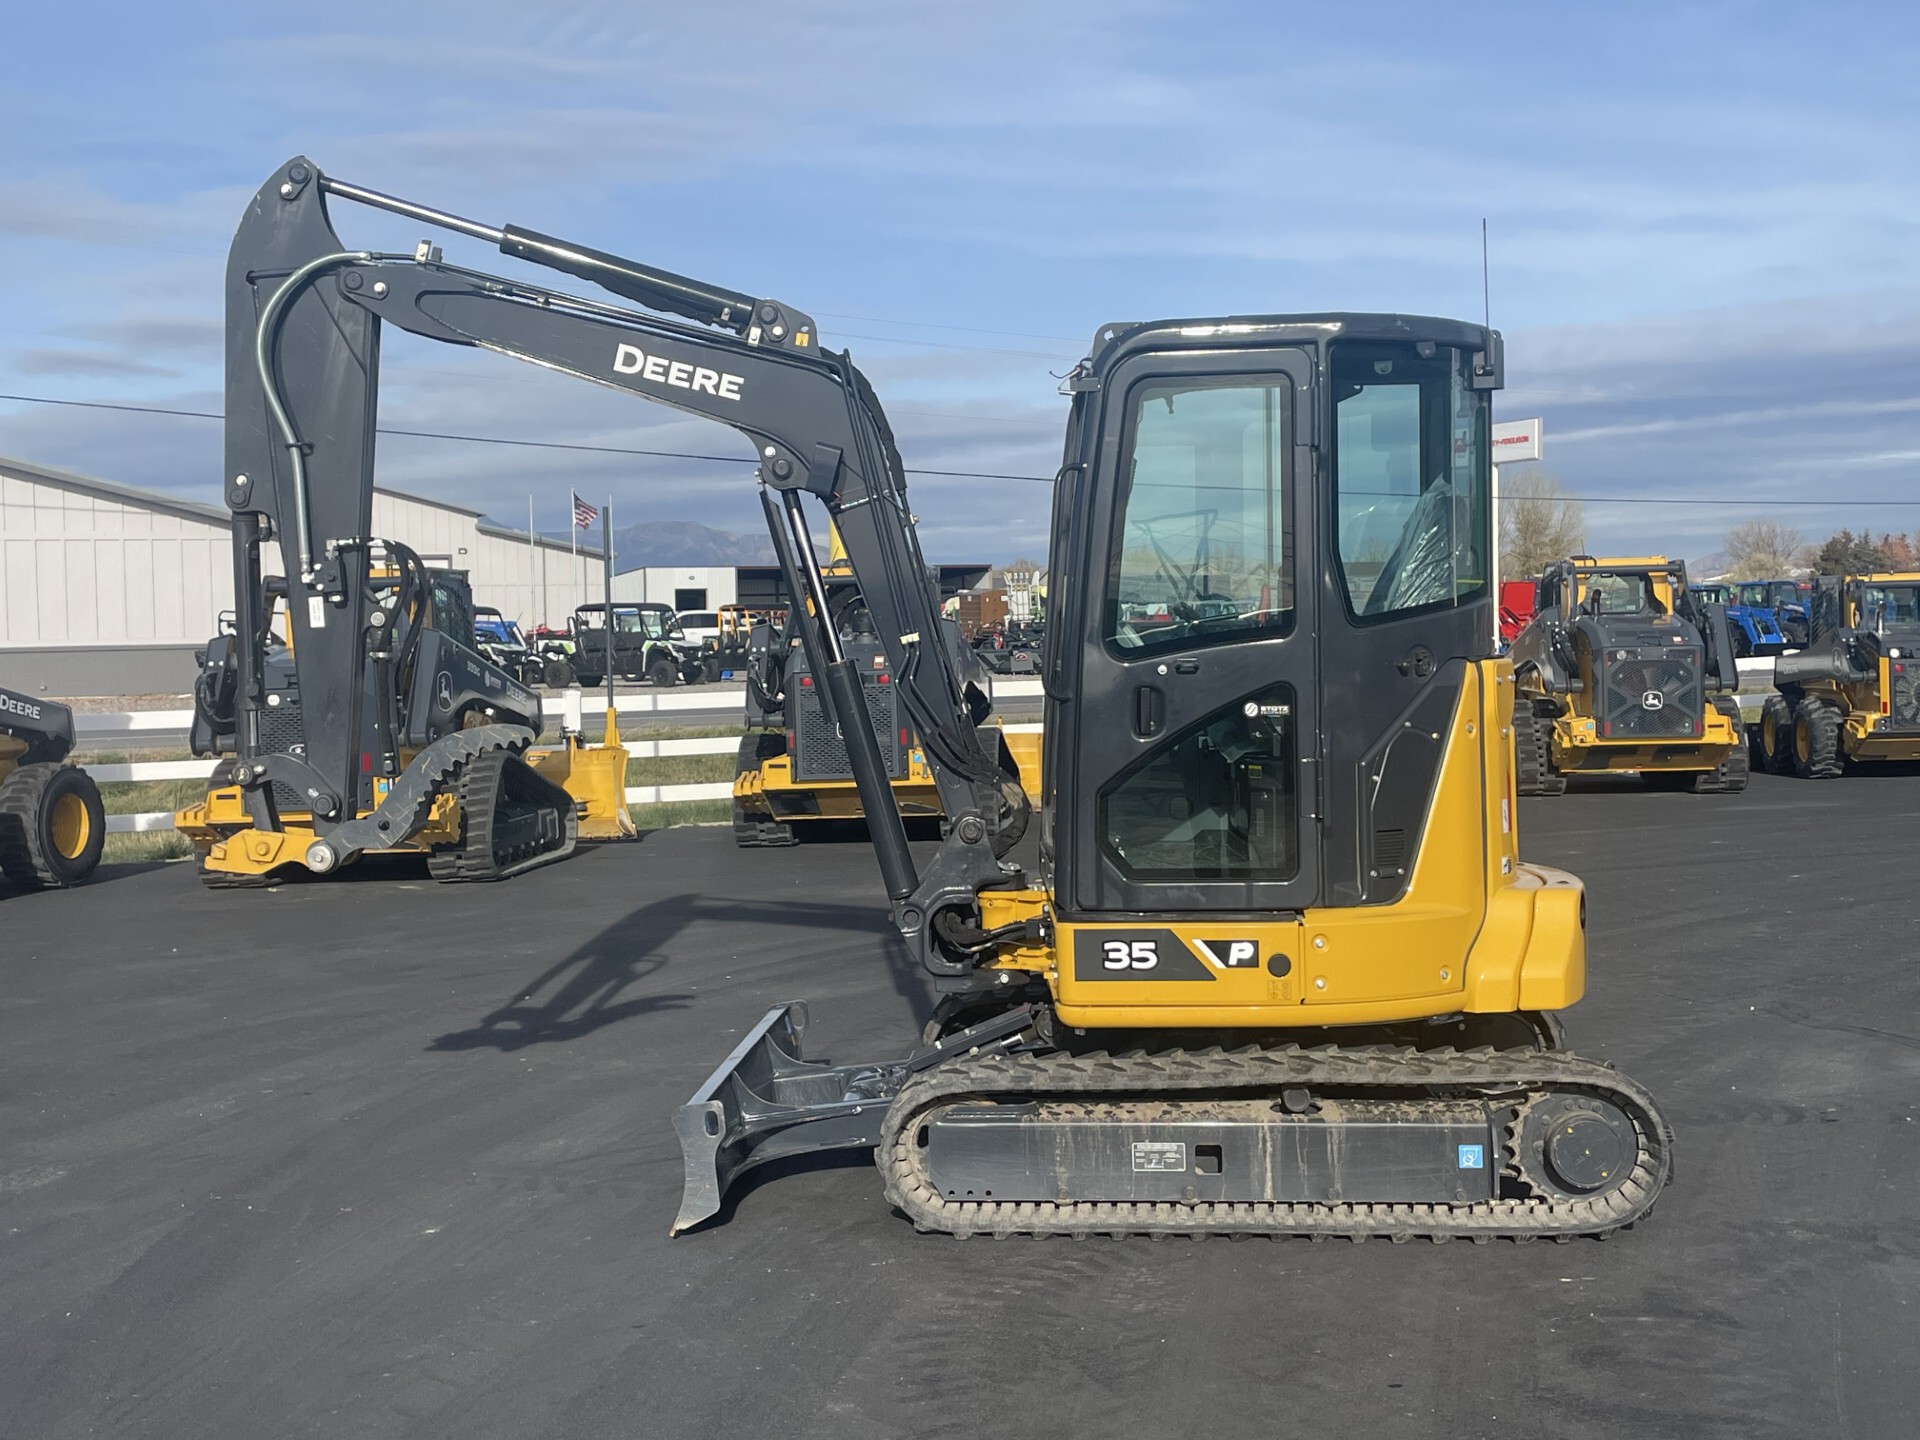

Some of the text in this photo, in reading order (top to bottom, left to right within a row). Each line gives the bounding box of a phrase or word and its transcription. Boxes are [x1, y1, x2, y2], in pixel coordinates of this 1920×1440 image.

[613, 343, 745, 401] DEERE
[0, 694, 41, 720] DEERE
[506, 681, 528, 706] DEERE
[1103, 941, 1159, 971] 35
